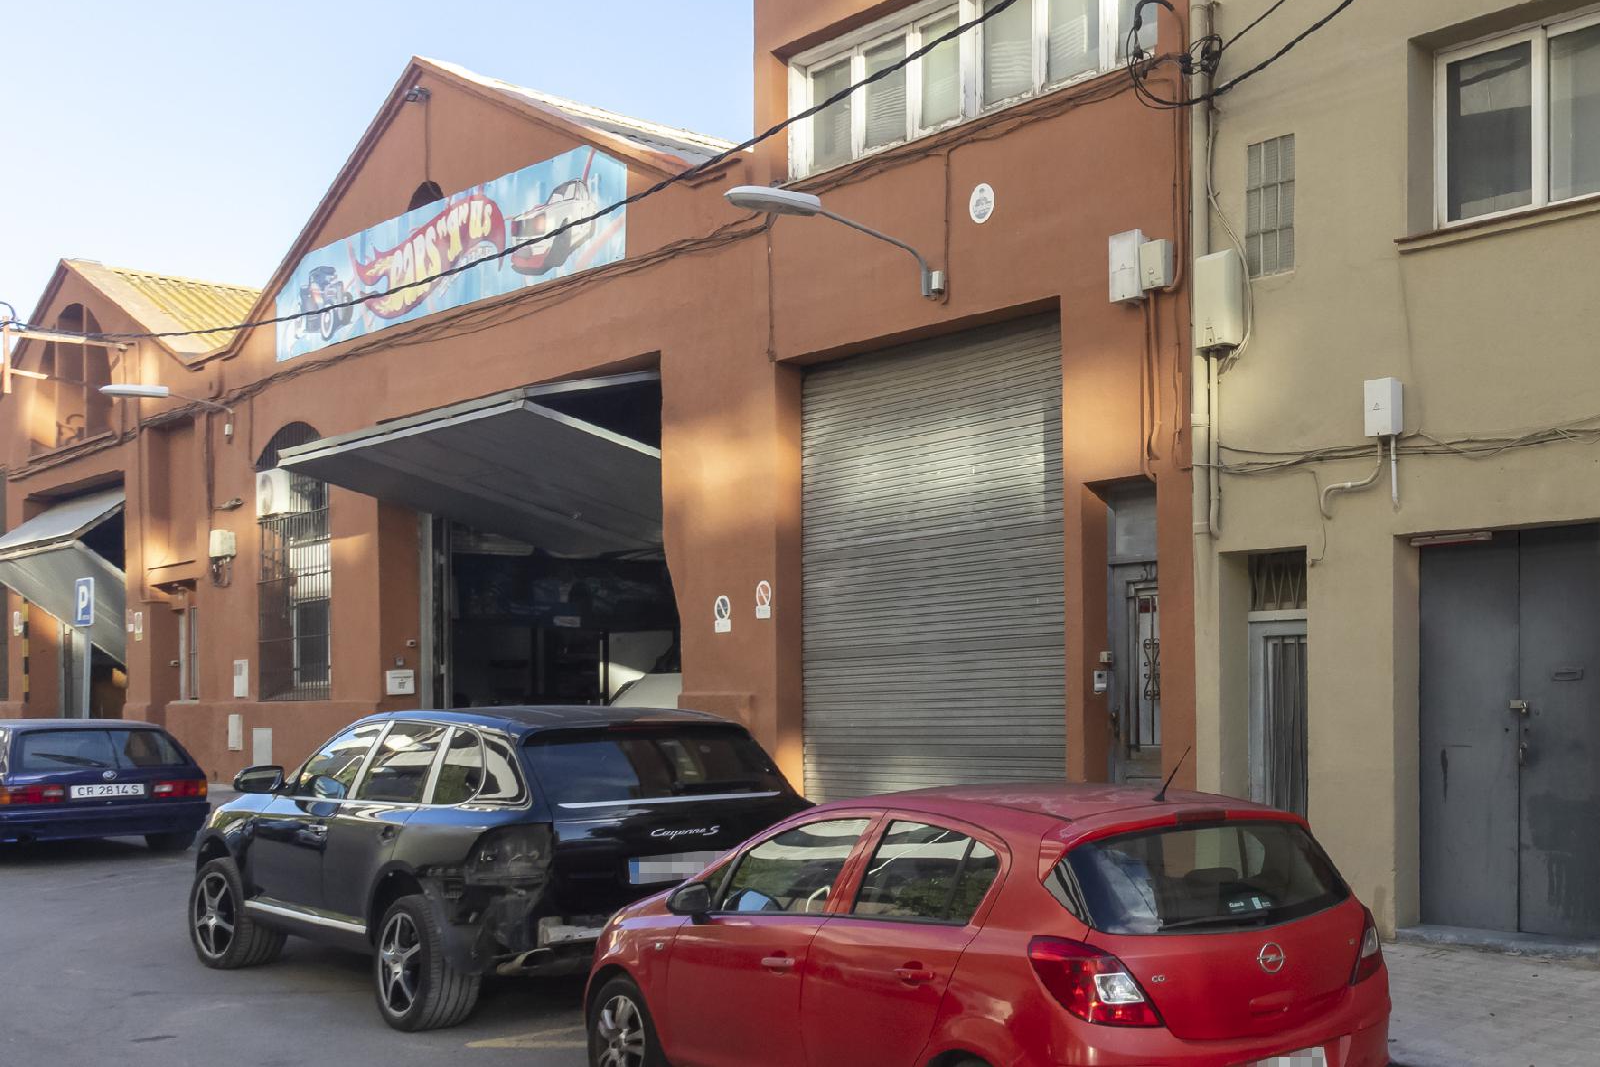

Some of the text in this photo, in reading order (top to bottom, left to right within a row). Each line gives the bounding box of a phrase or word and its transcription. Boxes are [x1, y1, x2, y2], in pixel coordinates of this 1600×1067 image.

[77, 585, 89, 621] P
[77, 786, 94, 796] CR
[98, 785, 129, 795] 2814
[703, 825, 720, 836] S
